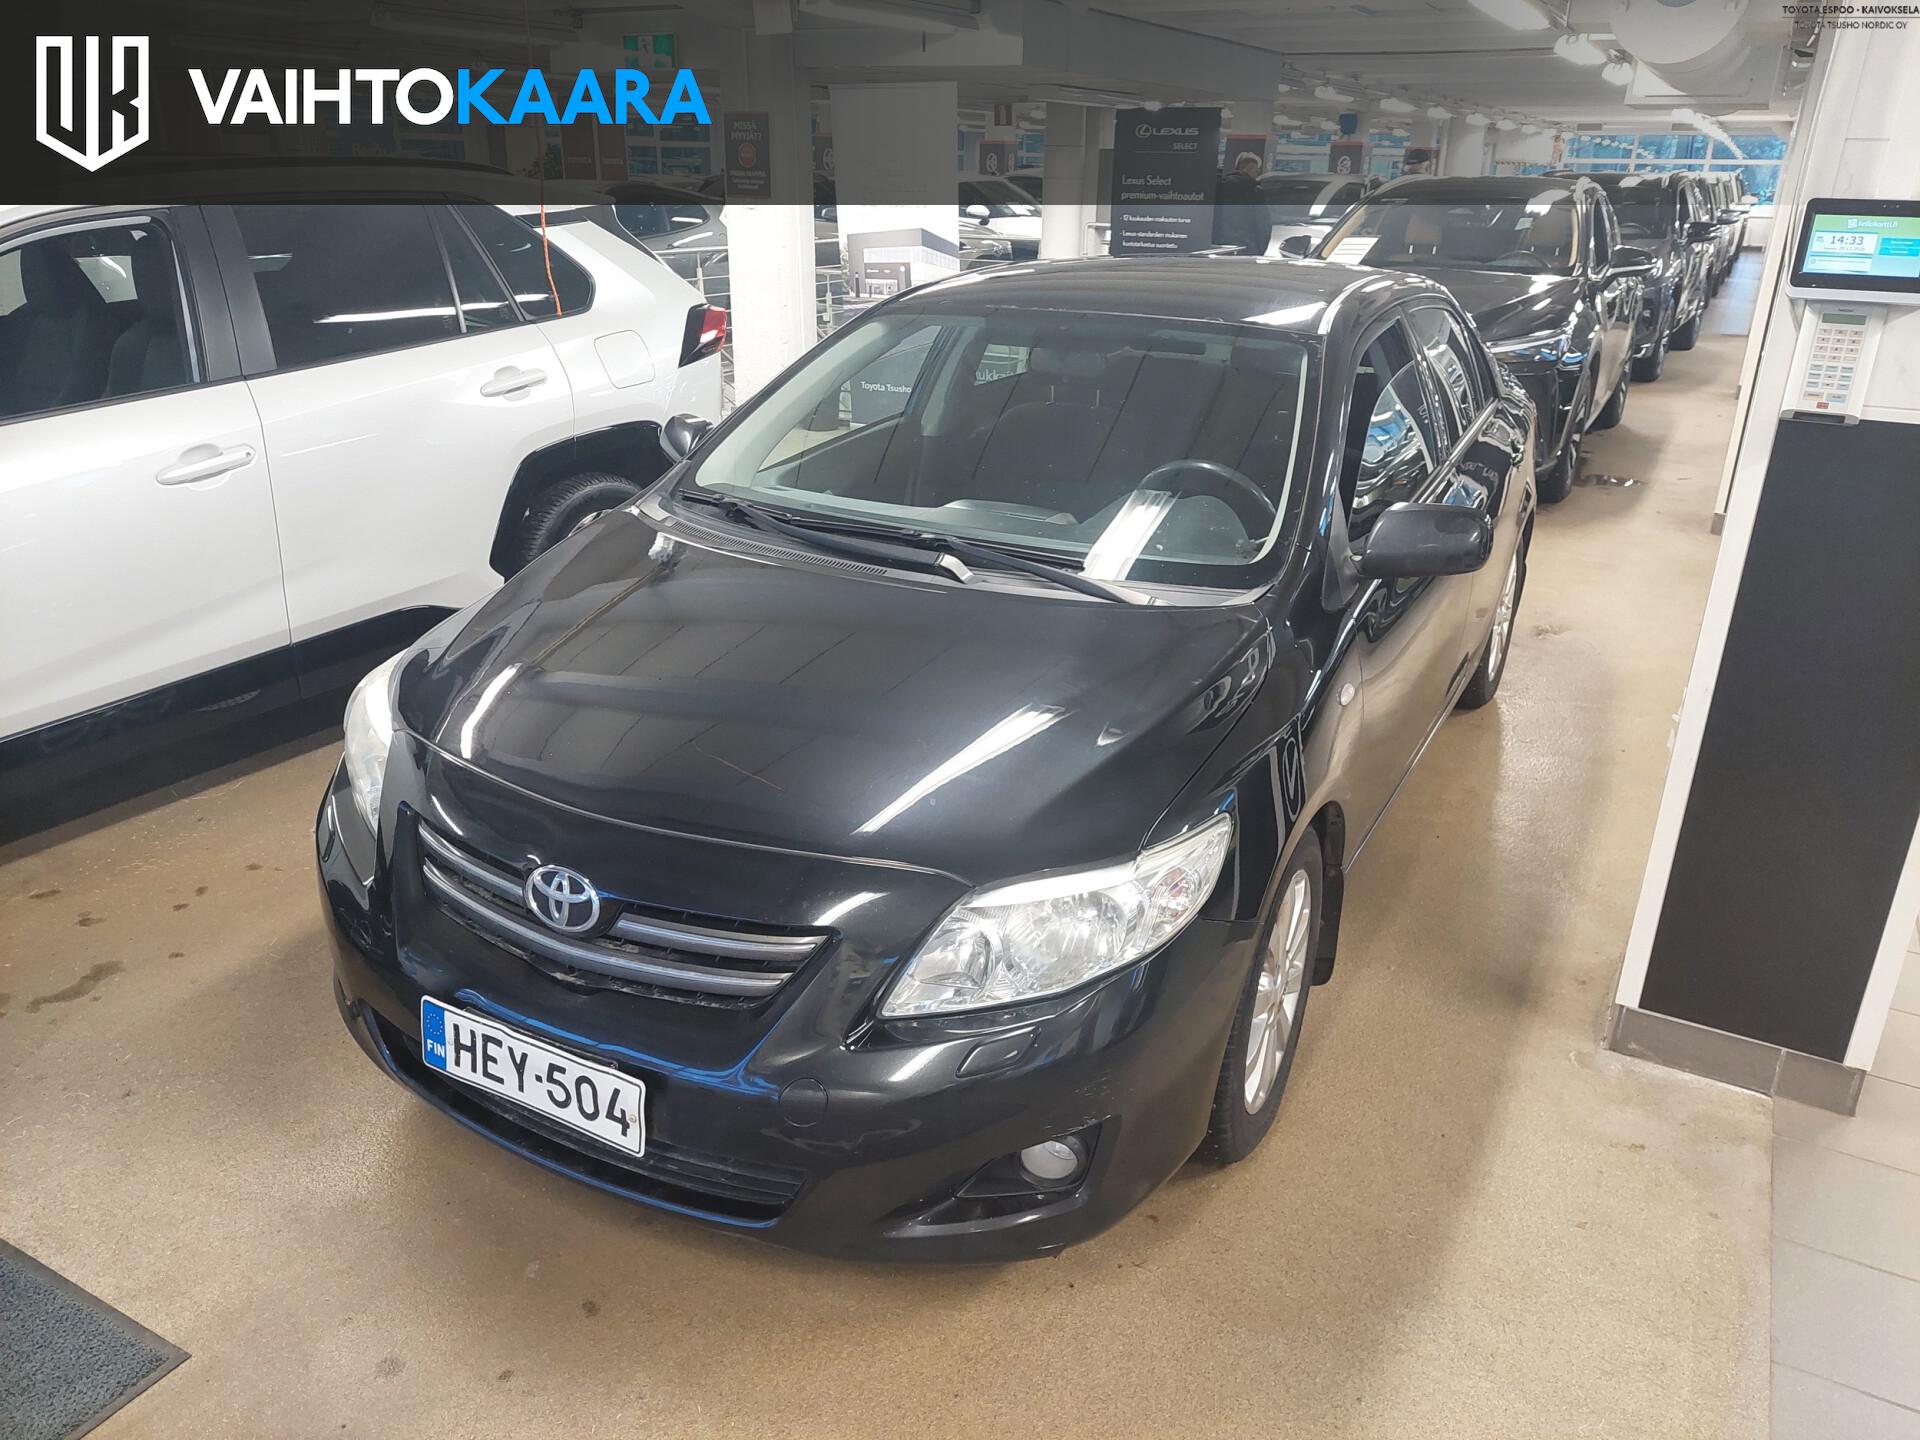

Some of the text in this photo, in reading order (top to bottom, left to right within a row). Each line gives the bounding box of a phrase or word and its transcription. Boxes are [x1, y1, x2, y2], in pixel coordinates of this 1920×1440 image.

[1153, 127, 1200, 136] LEXUS
[1172, 142, 1198, 150] SELECT
[1121, 174, 1172, 186] Lexus Select
[1830, 235, 1865, 245] 14:33
[861, 381, 911, 393] Toyota Tsusho
[427, 1039, 445, 1058] FIN
[453, 1023, 631, 1138] HEY-504
